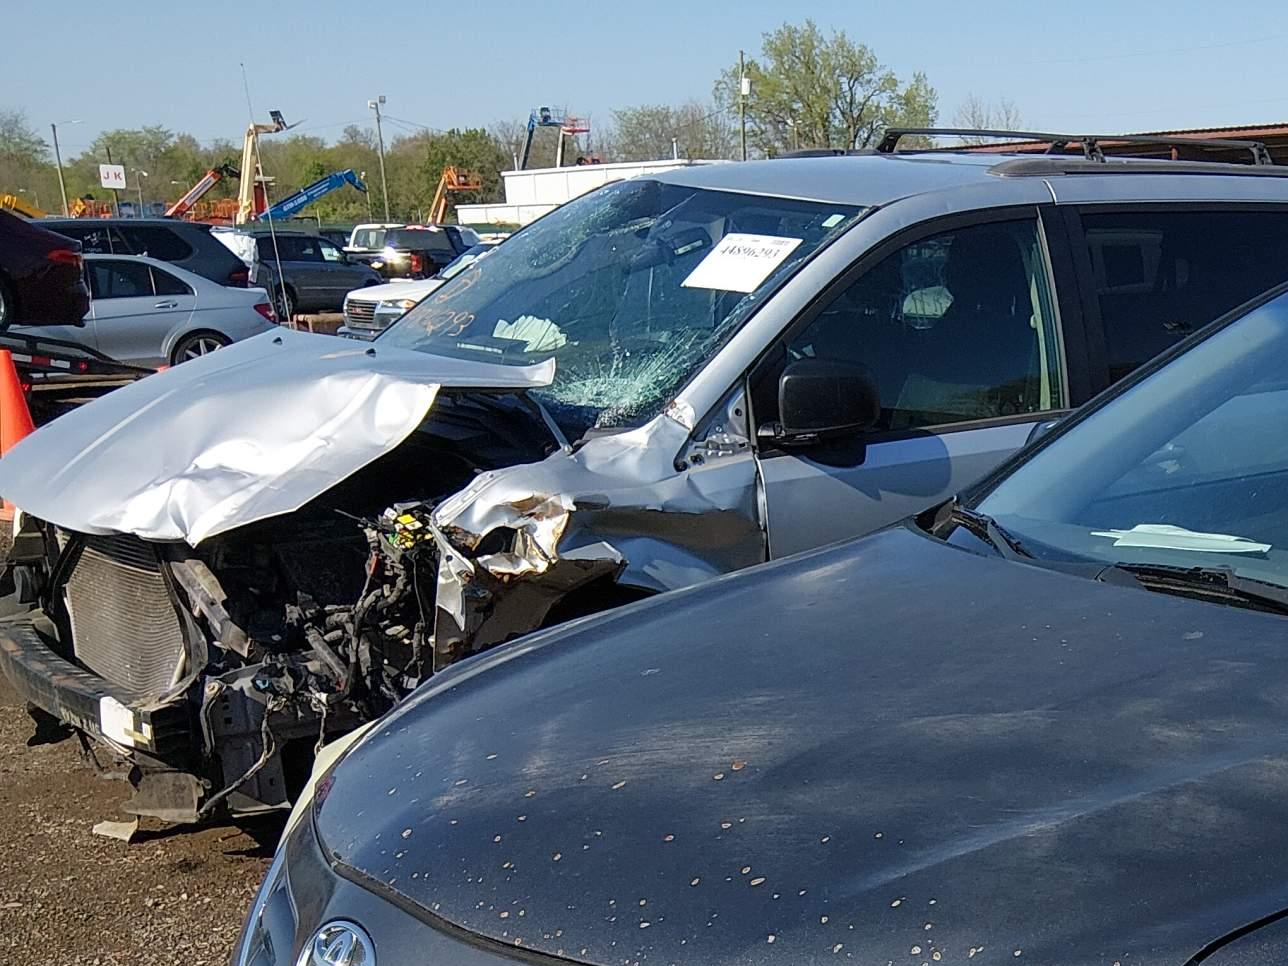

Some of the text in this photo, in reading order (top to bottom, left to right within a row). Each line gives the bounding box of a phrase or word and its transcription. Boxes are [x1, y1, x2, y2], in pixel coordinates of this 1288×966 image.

[103, 171, 122, 181] J K
[720, 244, 780, 259] 44896293
